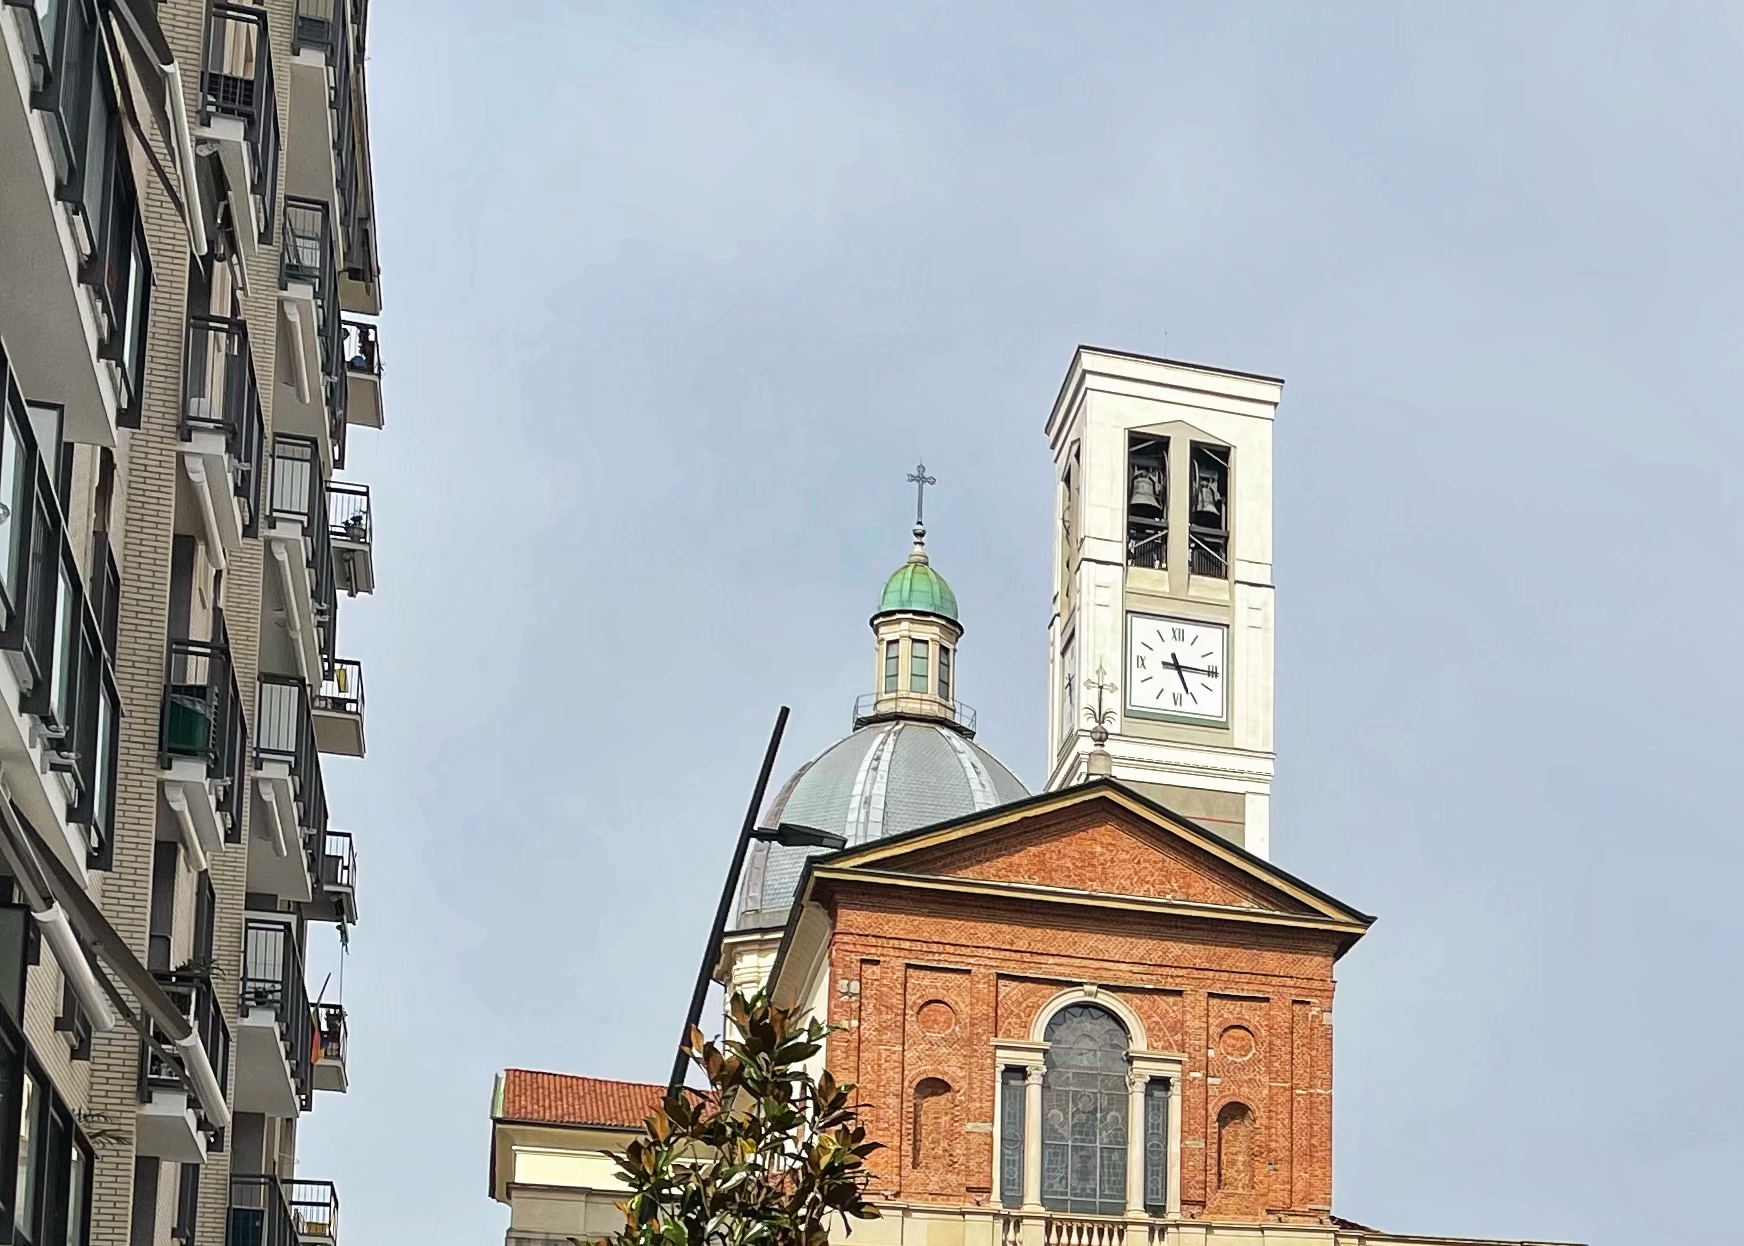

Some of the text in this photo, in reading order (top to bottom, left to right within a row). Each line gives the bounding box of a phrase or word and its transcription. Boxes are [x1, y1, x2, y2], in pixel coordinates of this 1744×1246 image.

[1171, 627, 1184, 642] XII
[1136, 655, 1146, 669] IX
[1207, 665, 1217, 679] III
[1172, 692, 1182, 707] VI
